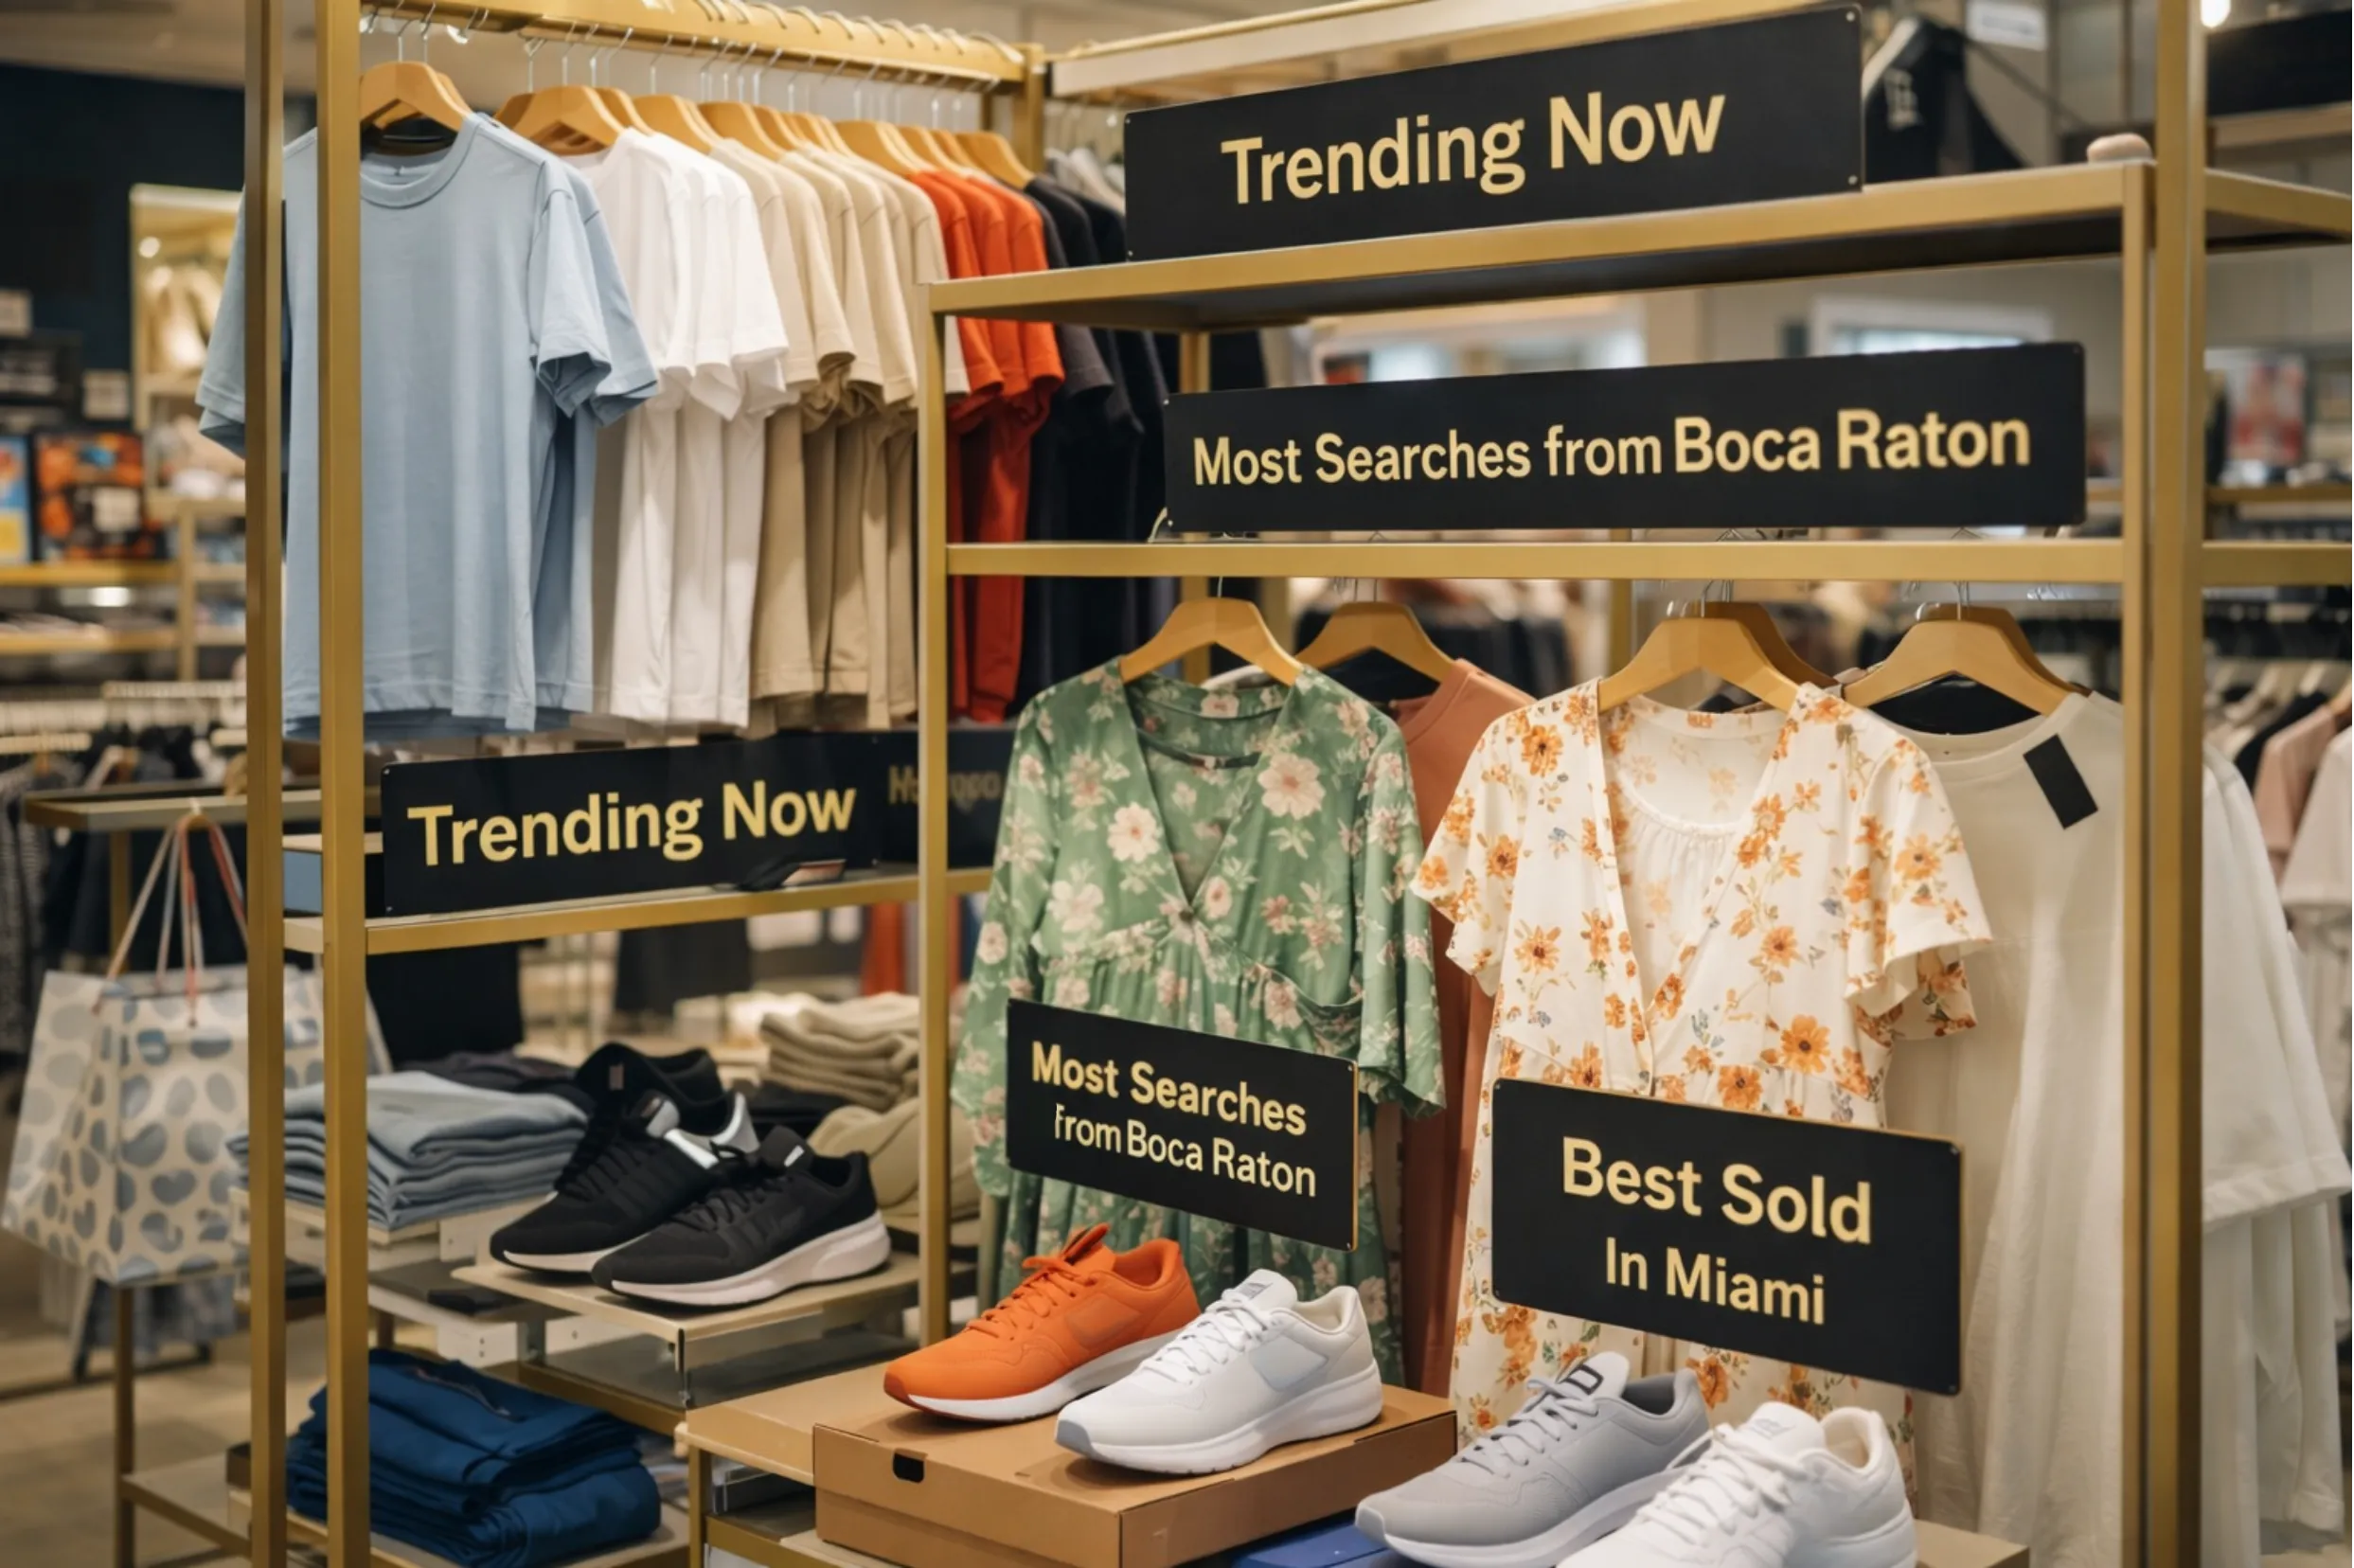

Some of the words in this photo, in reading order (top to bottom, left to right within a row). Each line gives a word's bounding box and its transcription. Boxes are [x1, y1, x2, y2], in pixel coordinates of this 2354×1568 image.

[1221, 114, 1525, 205] Trending
[1550, 91, 1725, 169] Now
[1194, 437, 1302, 486] Most
[1315, 429, 1531, 483] Searches
[1544, 424, 1662, 476] from
[1674, 416, 1820, 472] Boca
[1838, 409, 2029, 470] Raton
[407, 793, 703, 865] Trending
[723, 780, 855, 840] Now
[1032, 1040, 1119, 1098] Most
[1130, 1060, 1307, 1135] Searches
[1127, 1119, 1204, 1171] Boca
[1213, 1137, 1316, 1197] Raton
[1563, 1136, 1702, 1216] Best
[1721, 1163, 1871, 1244] Sold
[1606, 1237, 1648, 1291] In
[1667, 1247, 1825, 1325] Miami
